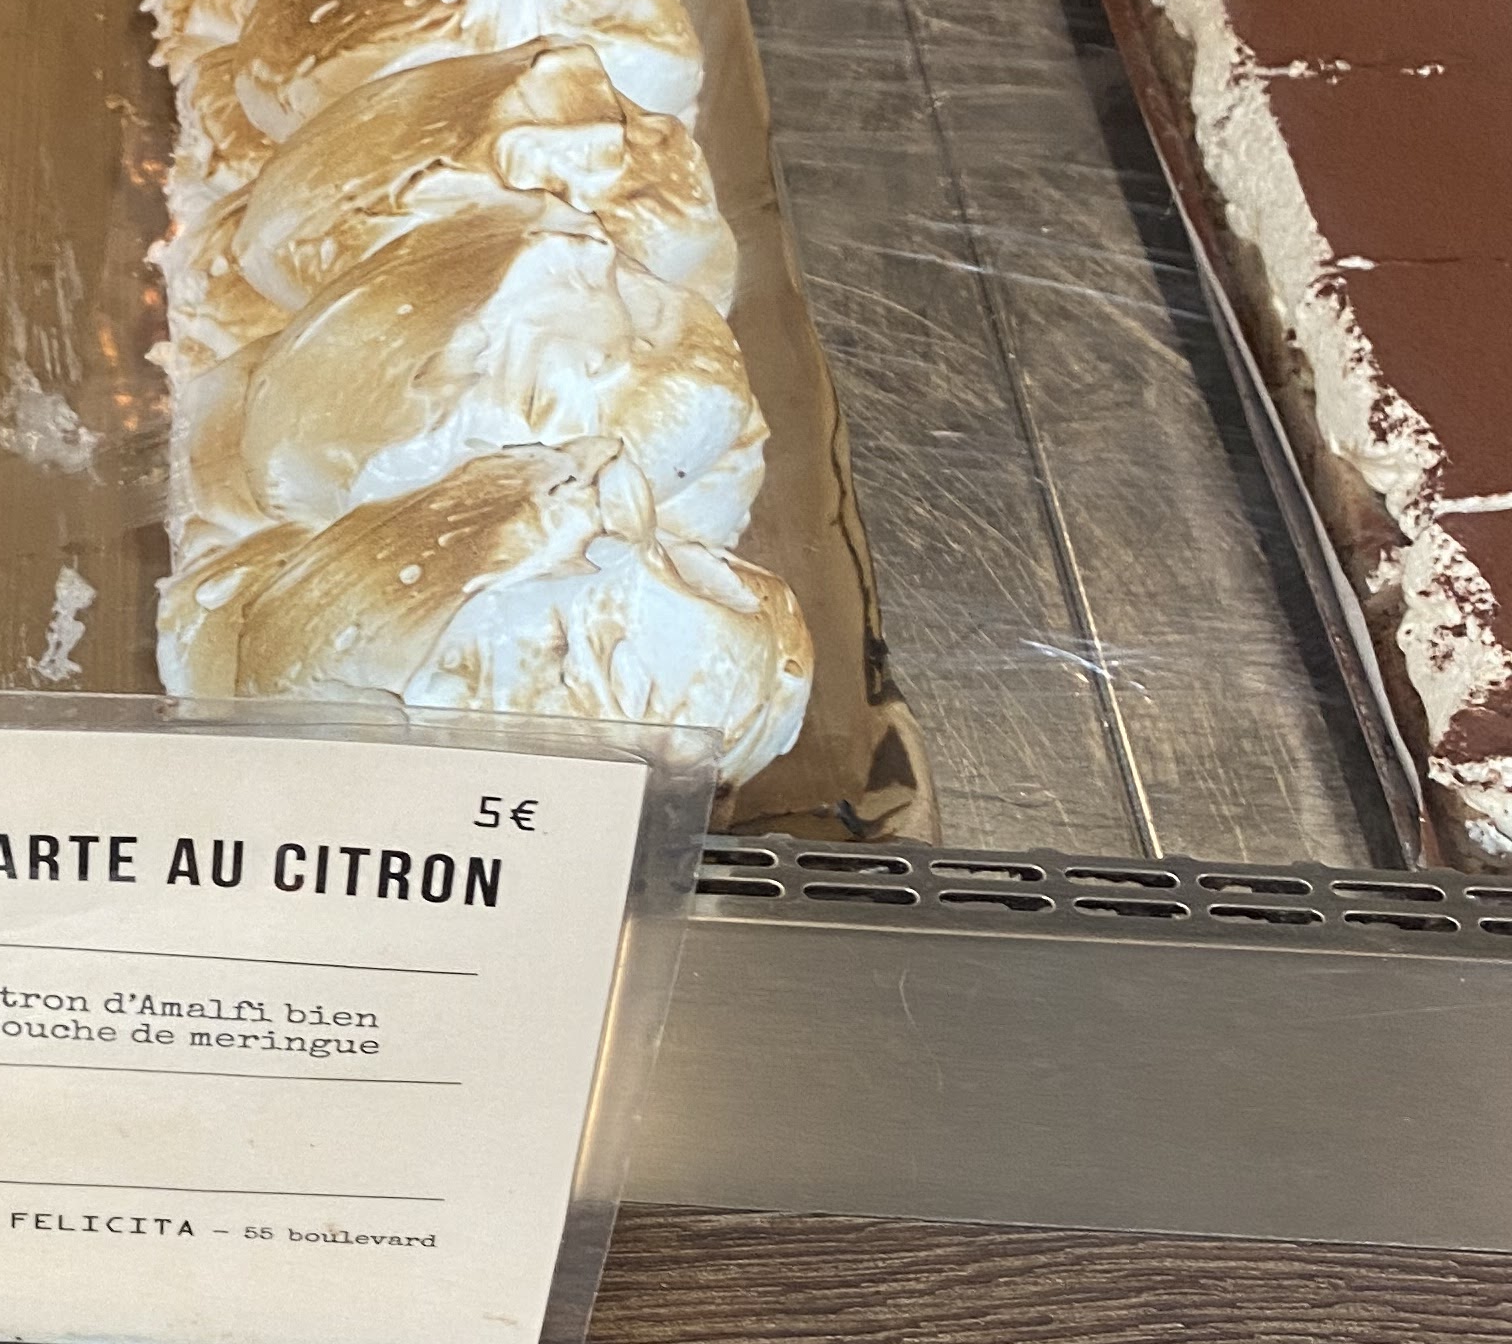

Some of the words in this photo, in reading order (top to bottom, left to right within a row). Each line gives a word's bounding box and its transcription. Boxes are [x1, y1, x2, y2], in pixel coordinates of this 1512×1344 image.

[473, 795, 539, 832] 5€
[166, 837, 245, 889] AU
[273, 842, 504, 908] CITRON
[285, 1002, 380, 1029] bien
[130, 1022, 177, 1047] de
[189, 1030, 381, 1058] meringue
[9, 1211, 196, 1237] FELICITA
[244, 1225, 275, 1241] 55
[288, 1227, 438, 1248] boulevard
